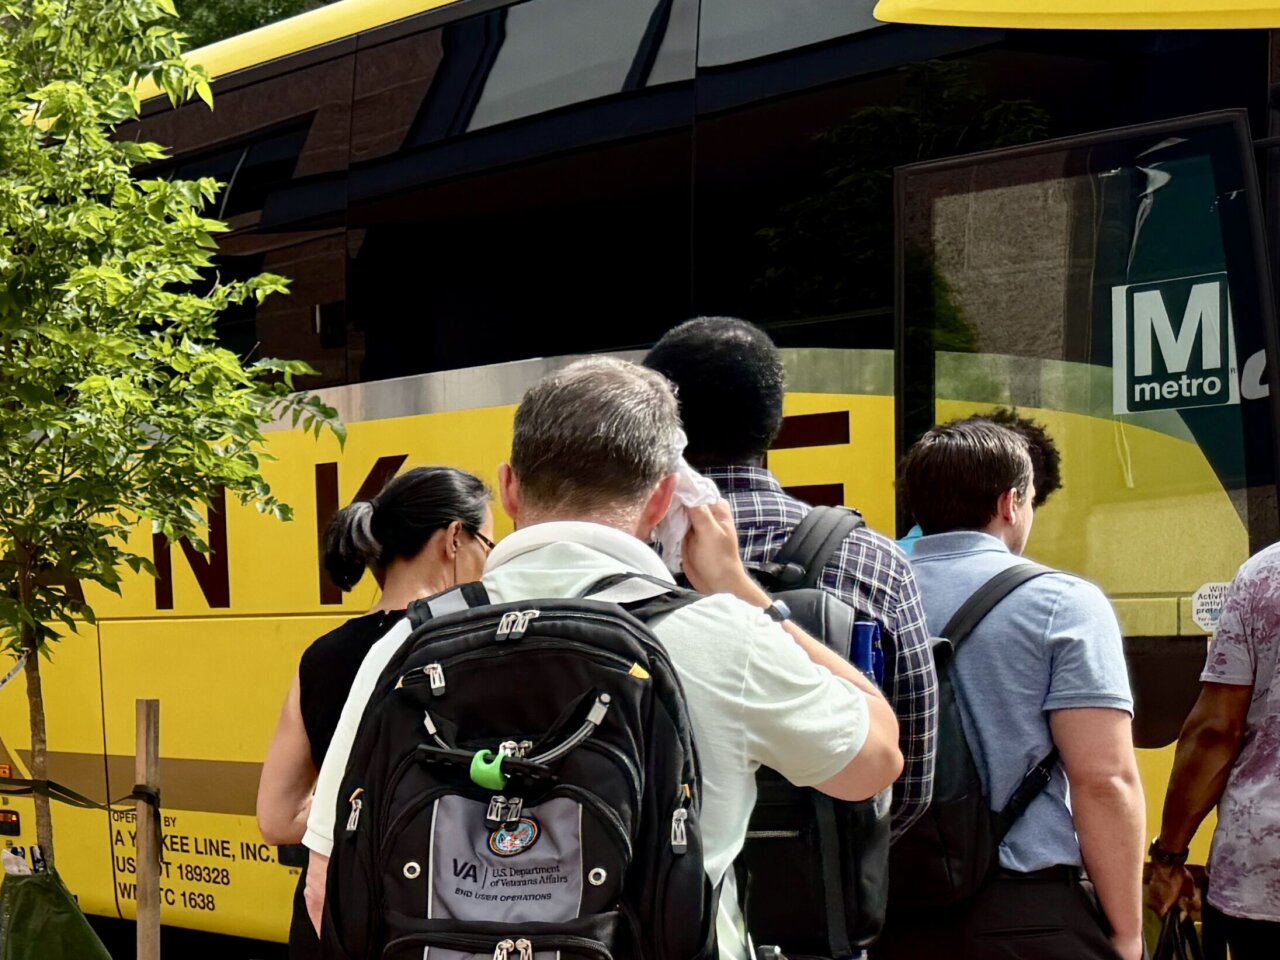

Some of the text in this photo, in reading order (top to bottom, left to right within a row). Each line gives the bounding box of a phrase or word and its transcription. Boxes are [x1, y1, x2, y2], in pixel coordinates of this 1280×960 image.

[1133, 281, 1221, 377] M
[1134, 374, 1222, 402] metro
[164, 816, 176, 827] BY
[115, 829, 275, 863] A YKEE LINE, INC.
[177, 863, 230, 886] 189328
[452, 858, 478, 883] VA
[500, 876, 538, 888] Veterans
[539, 872, 568, 885] Affairs
[509, 864, 560, 878] Department
[180, 891, 215, 911] 1638
[474, 891, 498, 901] USER
[500, 892, 552, 902] OPERATIONS
